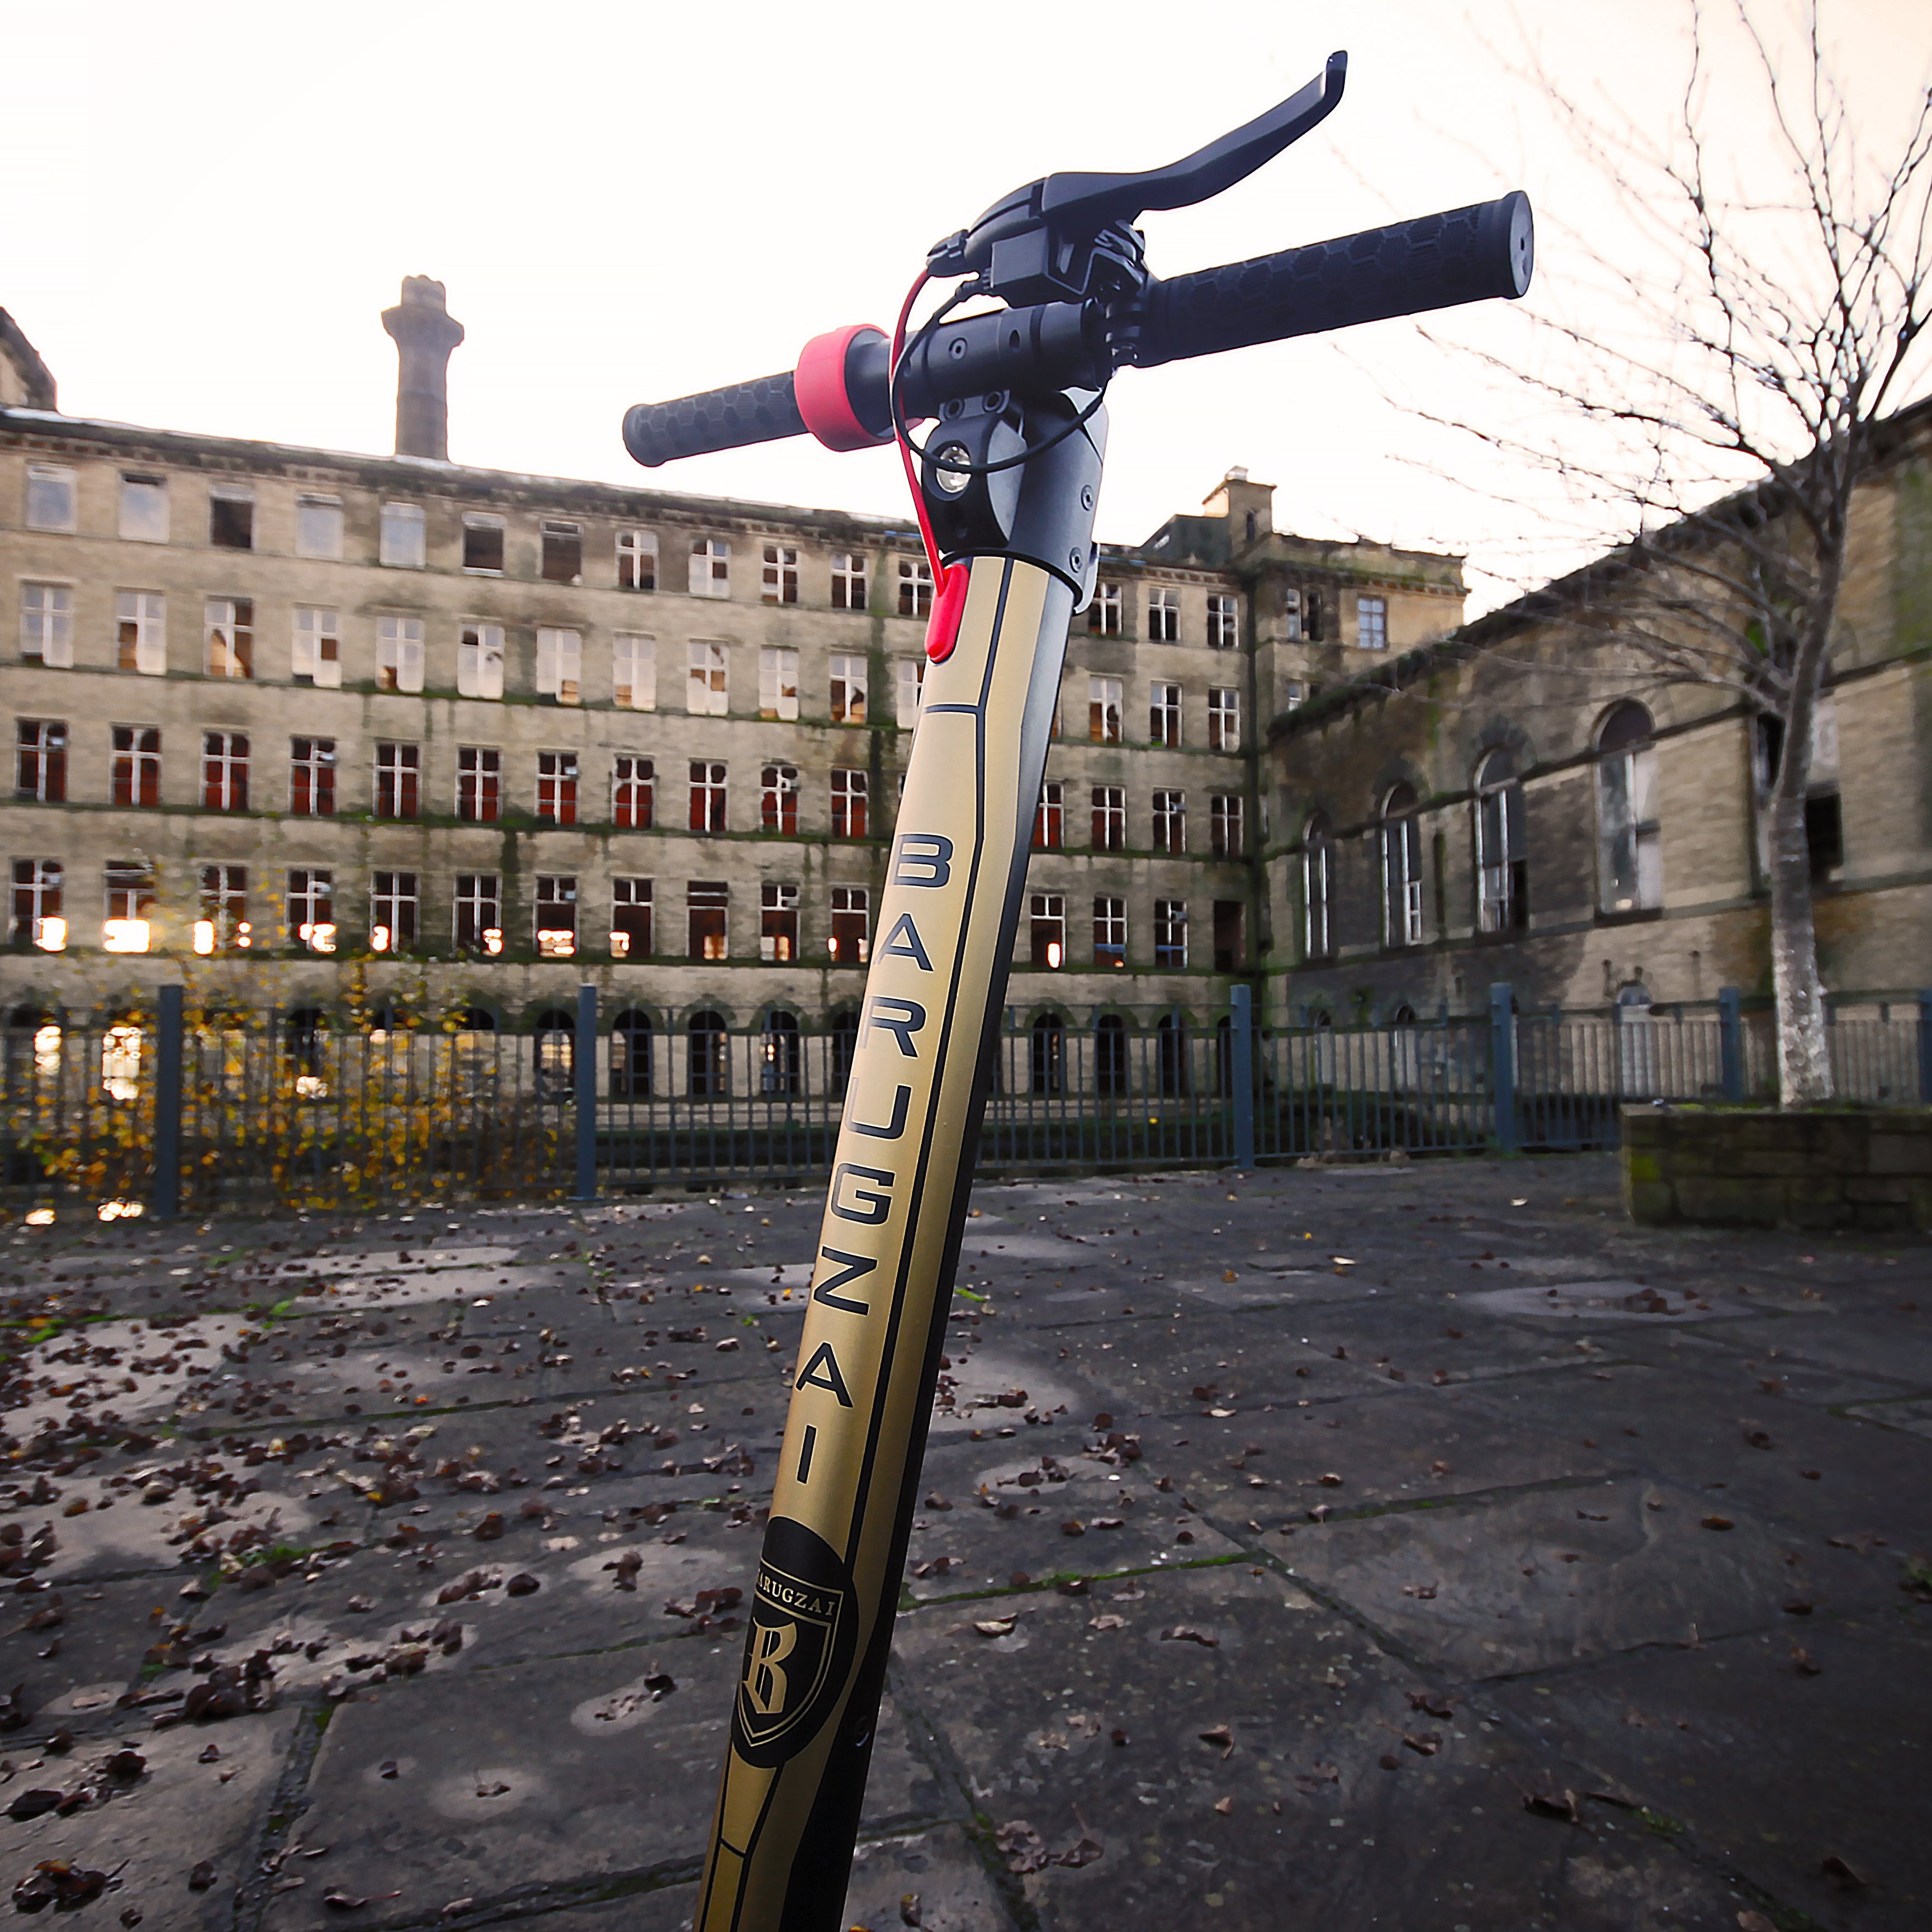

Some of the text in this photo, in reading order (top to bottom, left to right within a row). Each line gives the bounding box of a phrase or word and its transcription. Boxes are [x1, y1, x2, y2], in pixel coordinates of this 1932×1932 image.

[795, 834, 954, 1484] BARUGZAI
[757, 1569, 836, 1616] ARUGZAI
[741, 1617, 797, 1715] B
